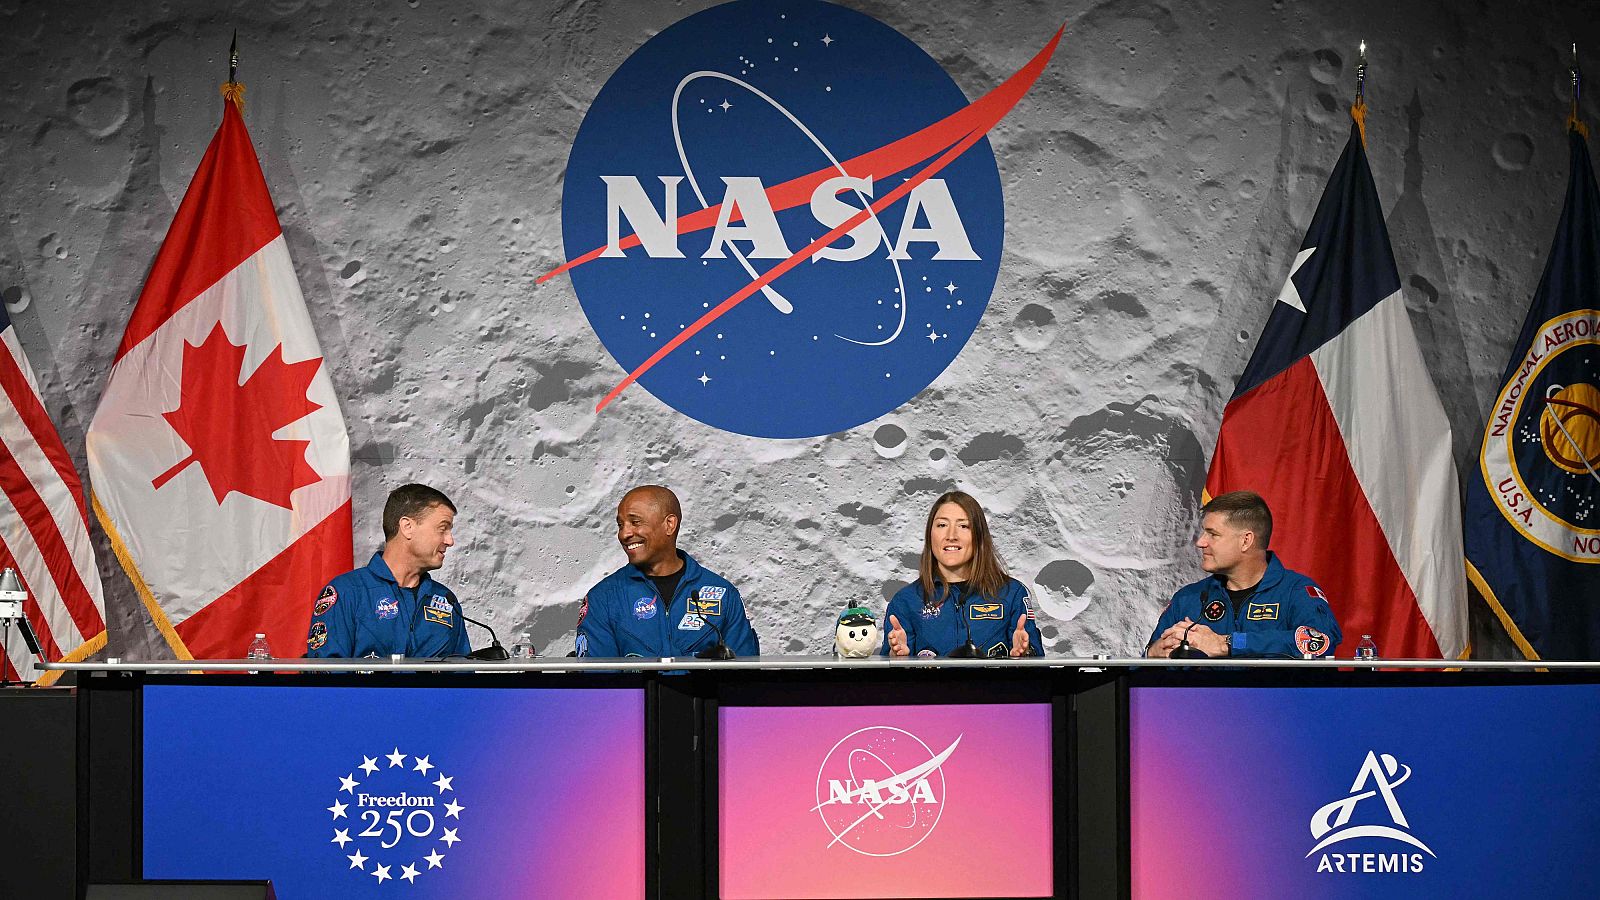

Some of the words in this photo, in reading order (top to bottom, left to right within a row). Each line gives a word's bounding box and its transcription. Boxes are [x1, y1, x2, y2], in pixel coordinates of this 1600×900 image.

[598, 174, 983, 264] NASA
[1491, 352, 1543, 437] NATIONAL
[1498, 477, 1534, 528] U.S.A.
[636, 604, 656, 613] NASA
[357, 792, 435, 807] Freedom
[828, 778, 938, 805] NASA
[357, 808, 435, 849] 250
[1316, 853, 1424, 873] ARTEMIS
